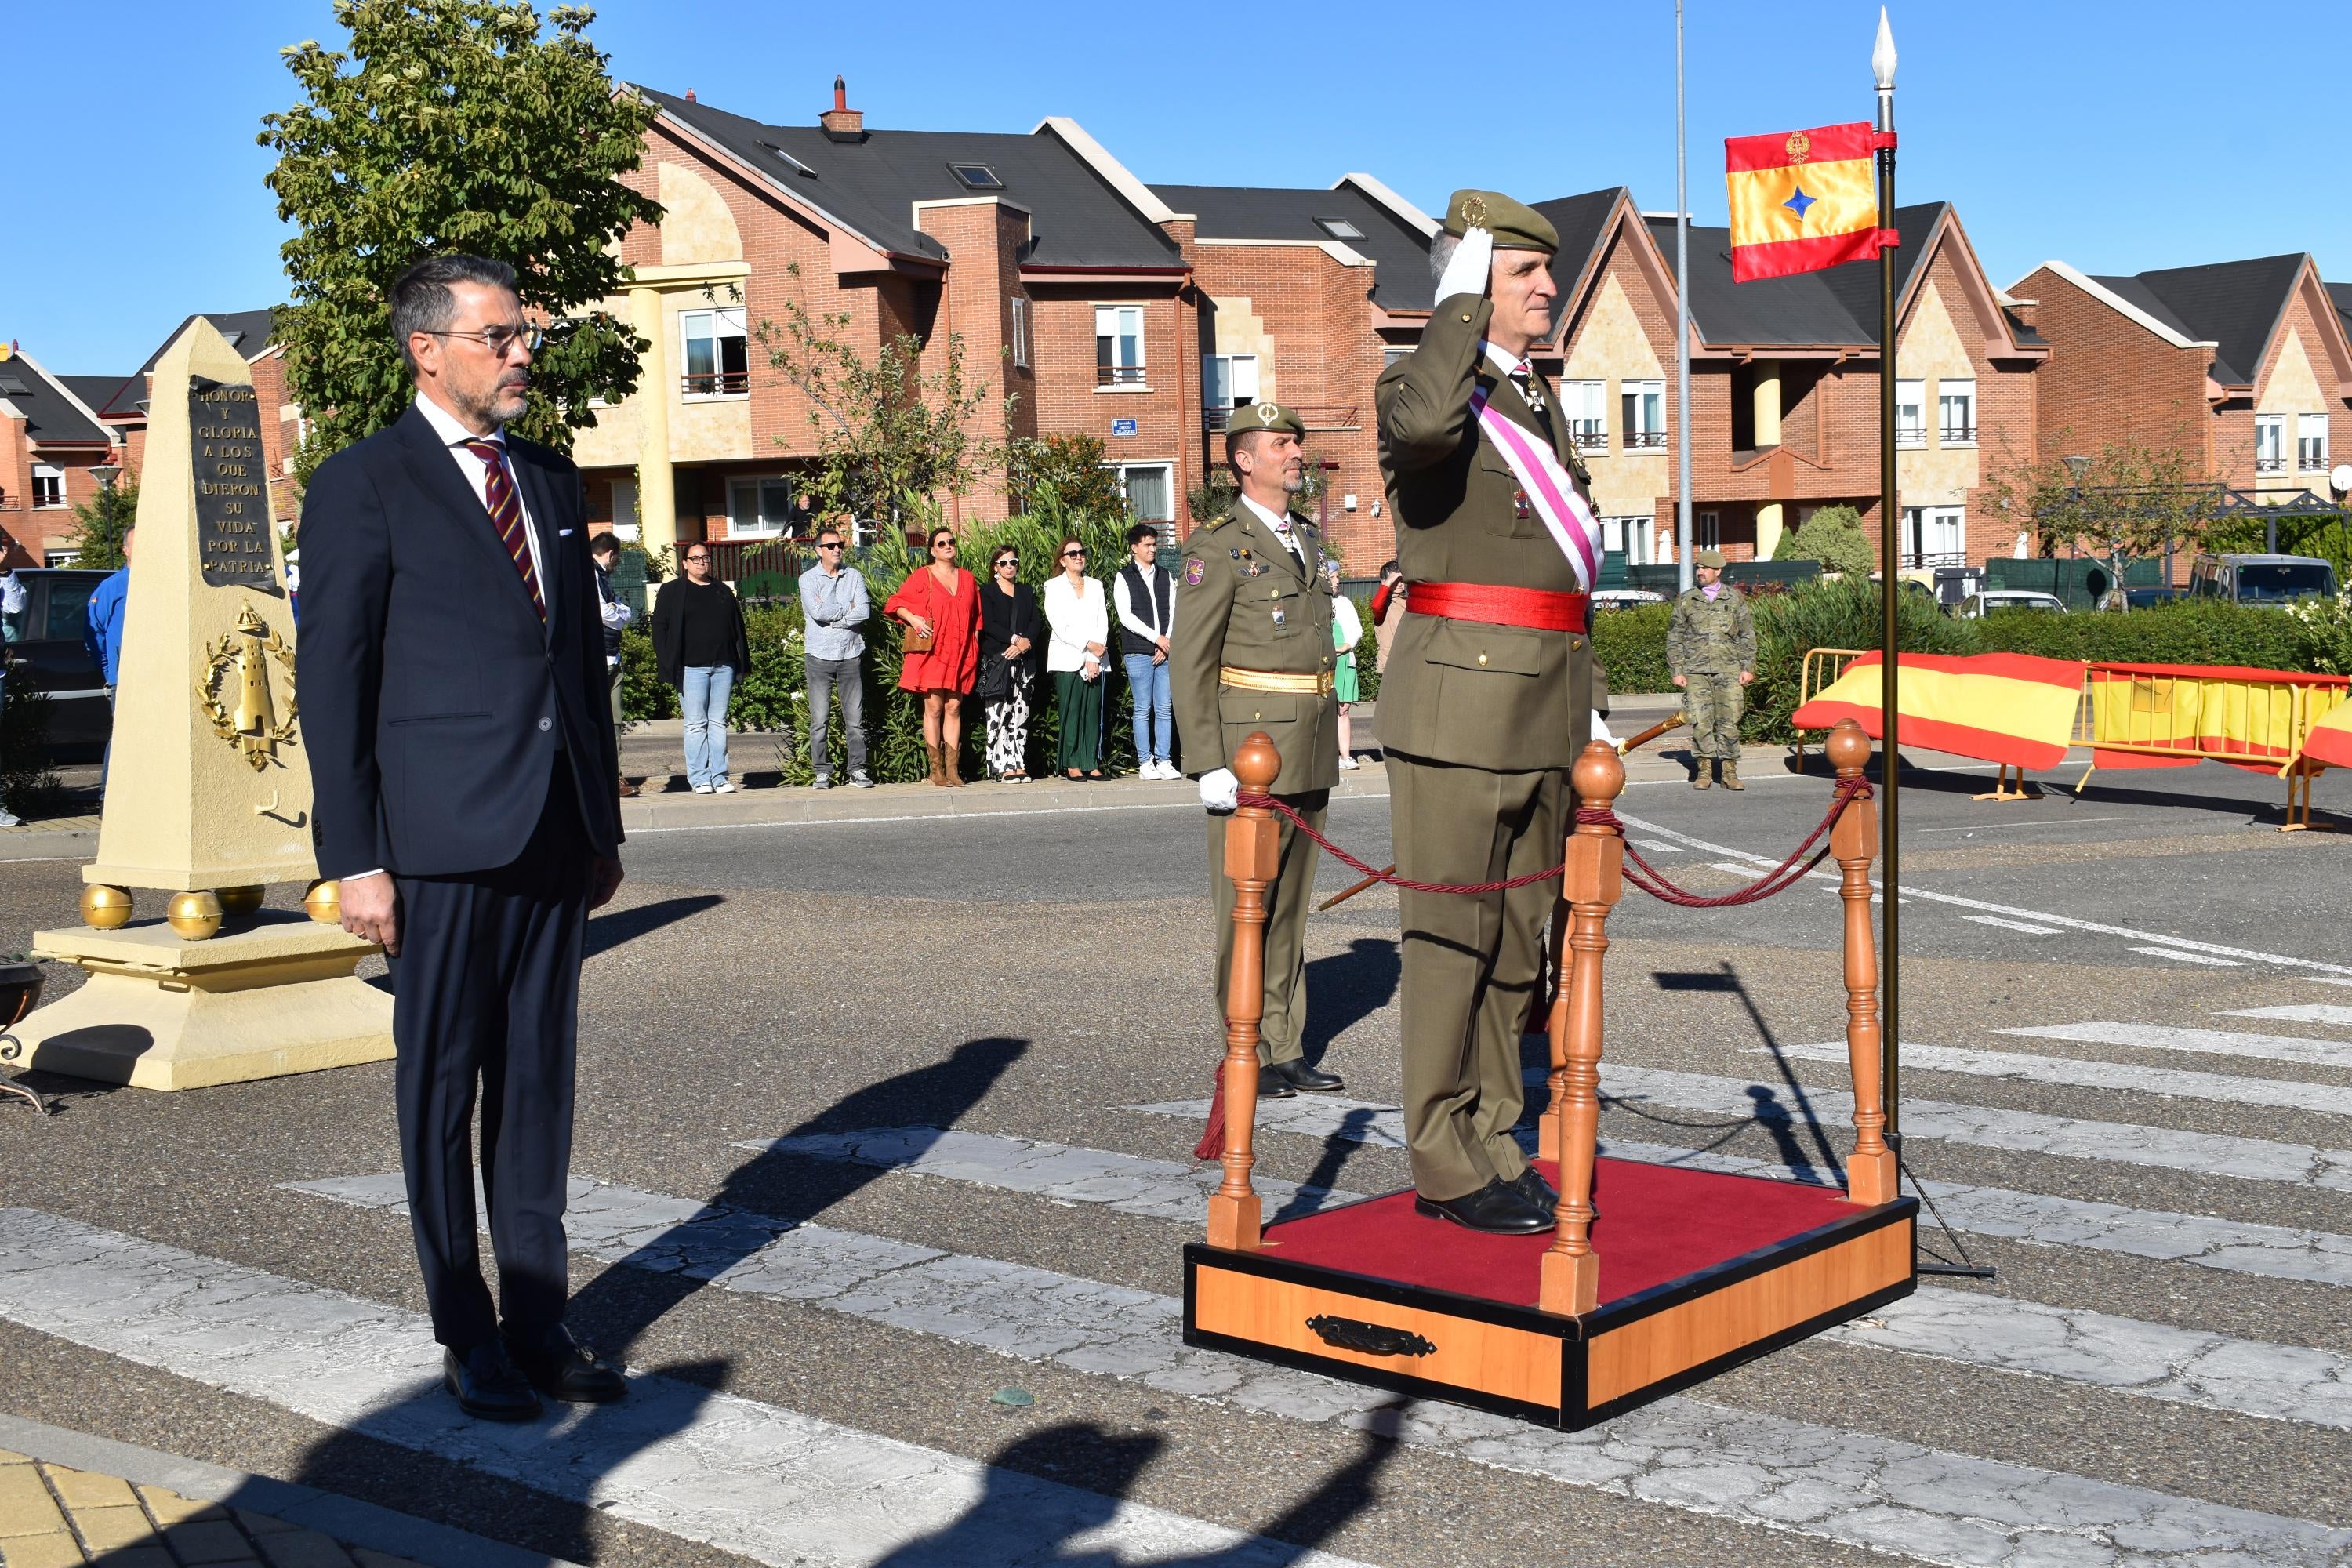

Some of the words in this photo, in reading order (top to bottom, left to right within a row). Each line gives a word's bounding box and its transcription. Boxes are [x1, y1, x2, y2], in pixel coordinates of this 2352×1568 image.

[200, 390, 249, 402] HONOR
[221, 408, 230, 420] Y
[199, 427, 258, 440] GLORIA
[205, 446, 213, 458] A
[221, 446, 252, 458] LOS
[218, 464, 248, 477] QUE
[203, 483, 260, 495] DIERON
[226, 503, 243, 514] SU
[216, 521, 256, 534] VIDA
[208, 541, 238, 553] POR
[245, 541, 264, 553] LA
[210, 560, 265, 572] PATRIA
